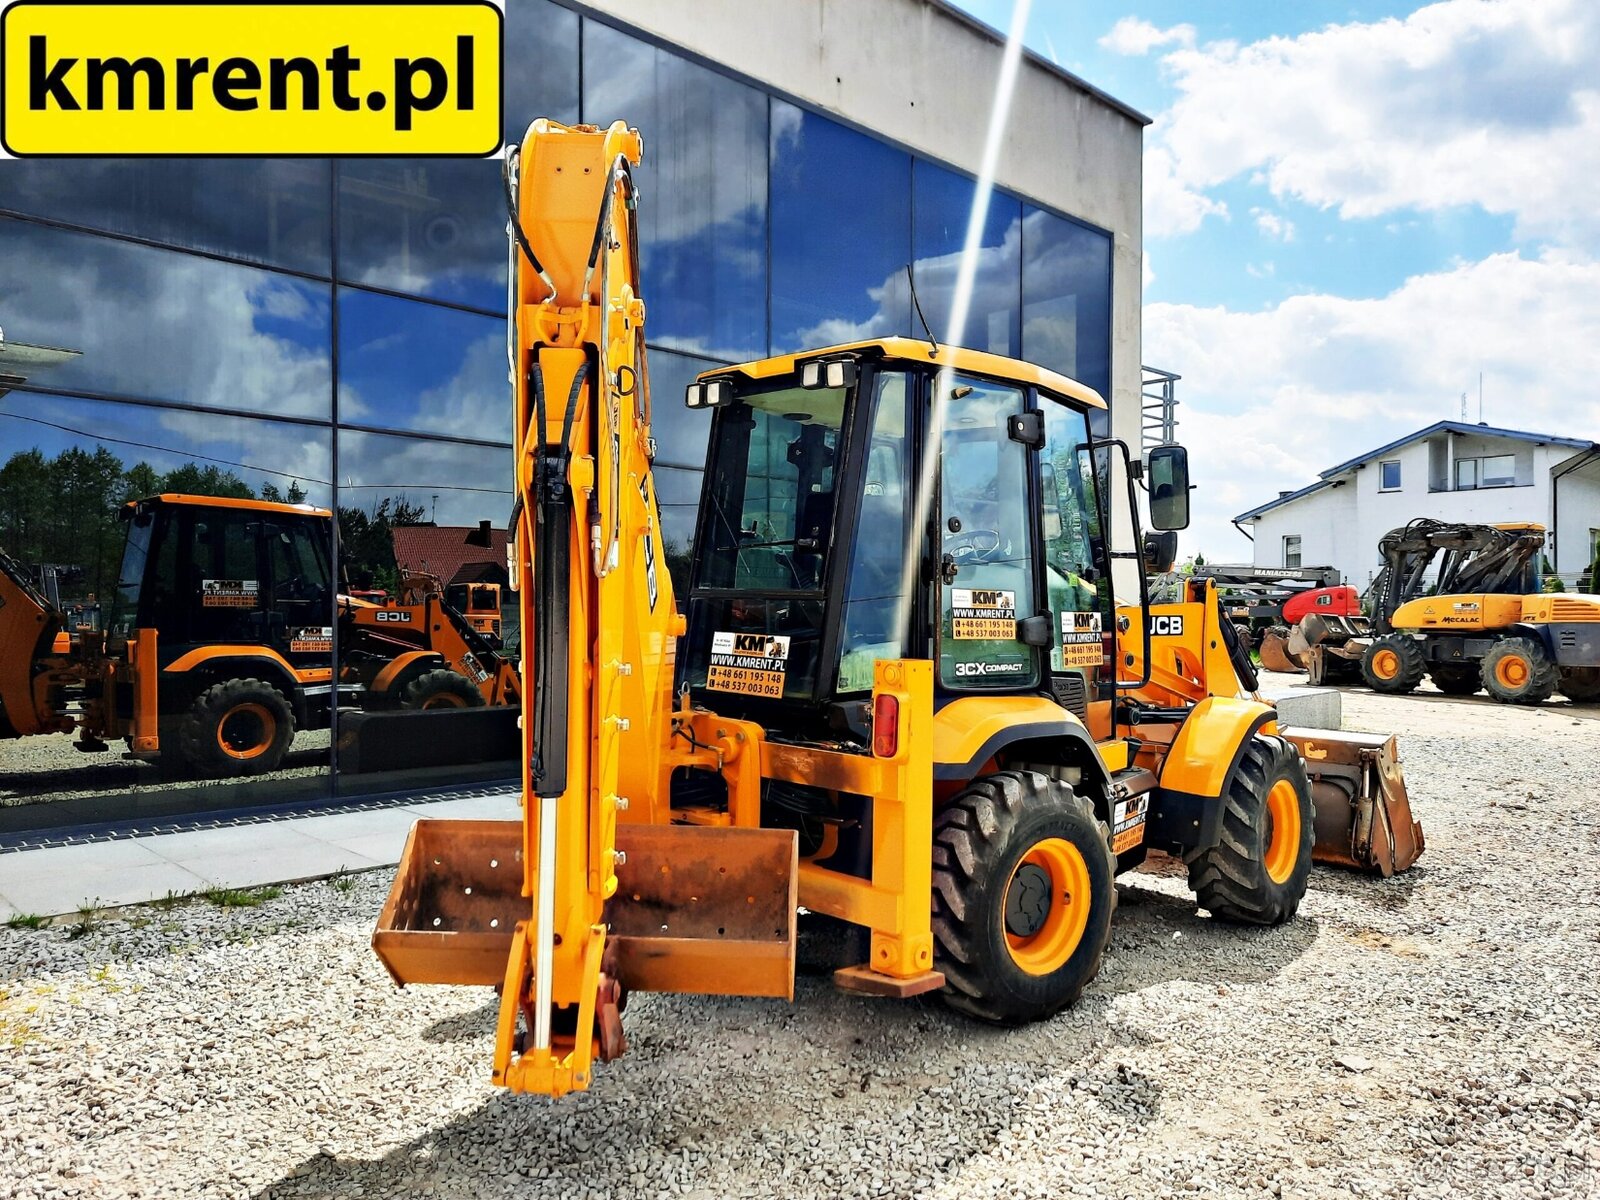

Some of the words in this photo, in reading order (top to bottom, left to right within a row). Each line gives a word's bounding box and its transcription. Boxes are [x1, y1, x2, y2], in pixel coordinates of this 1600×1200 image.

[972, 592, 997, 604] KM
[953, 609, 1015, 618] WWW.KMRENT.PL
[1074, 614, 1090, 627] KM
[975, 620, 987, 628] 661
[989, 620, 1001, 628] 195
[1150, 616, 1182, 634] JCB
[975, 630, 987, 638] 537
[989, 630, 1001, 638] 003
[735, 635, 766, 652] KM
[711, 654, 785, 671] WWW.KMRENT.PL
[955, 662, 987, 676] 3CX
[986, 663, 1023, 672] COMPACT
[718, 669, 732, 678] +48
[733, 670, 747, 680] 661
[750, 671, 764, 682] 195
[767, 673, 781, 683] 148
[716, 680, 730, 690] +48
[732, 681, 746, 691] 537
[748, 683, 762, 693] 003
[764, 685, 779, 695] 063
